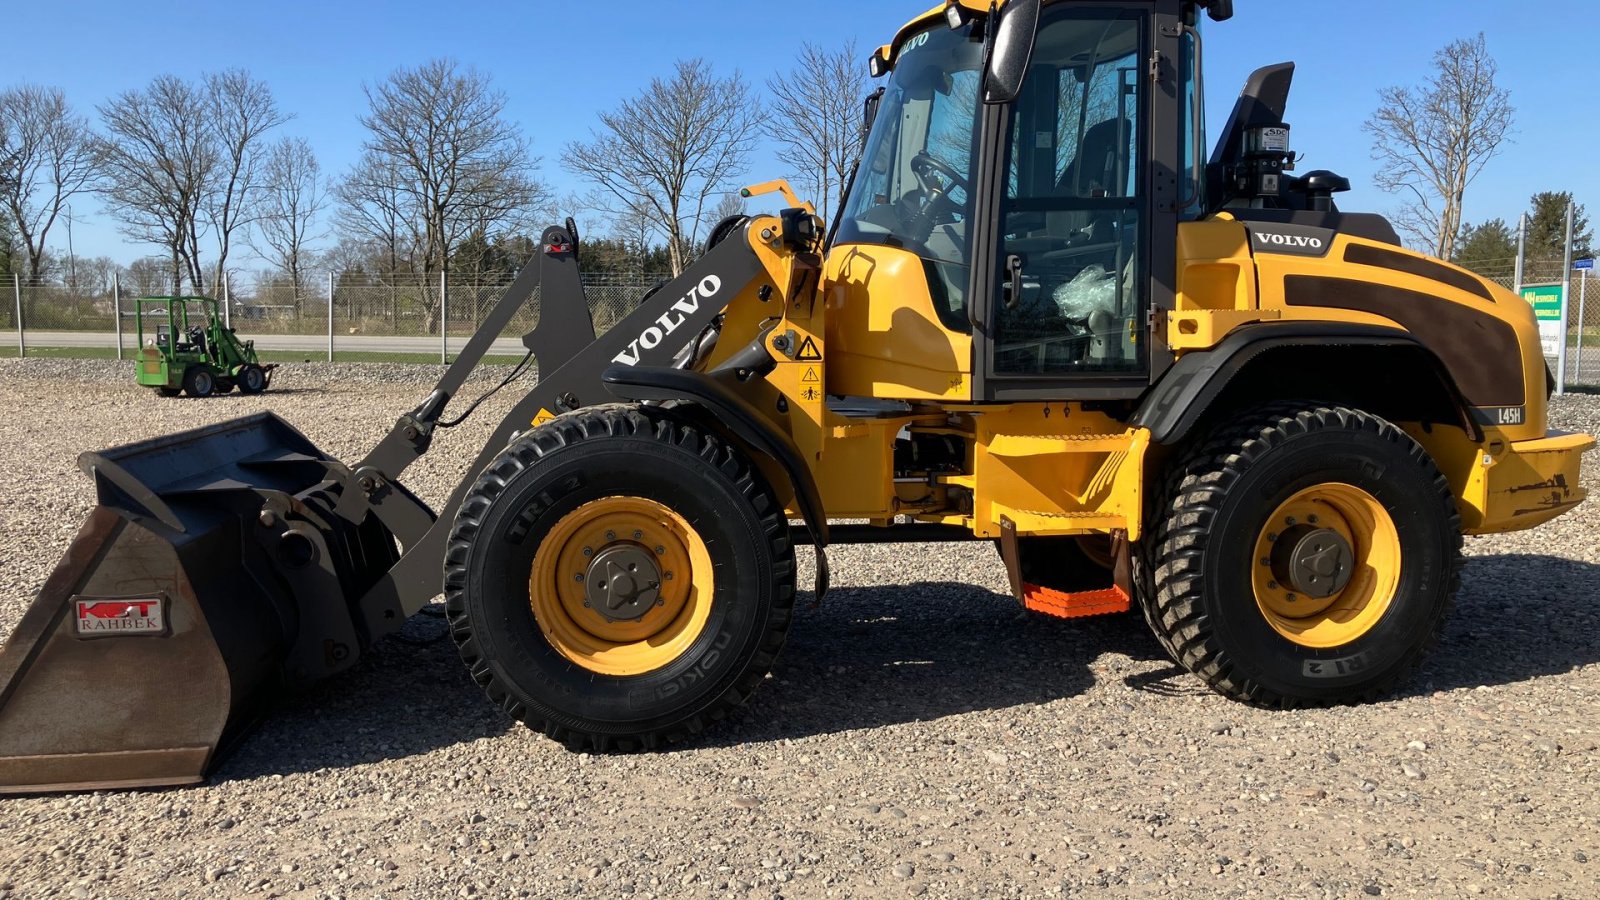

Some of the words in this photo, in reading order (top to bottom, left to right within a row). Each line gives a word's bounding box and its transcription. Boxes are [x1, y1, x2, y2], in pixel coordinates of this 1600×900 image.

[1255, 232, 1322, 248] VOLVO
[611, 274, 722, 367] VOLVO
[1498, 408, 1521, 424] L45H
[510, 490, 555, 537] TRI
[82, 618, 158, 630] RAHBEK
[1308, 662, 1323, 674] 2
